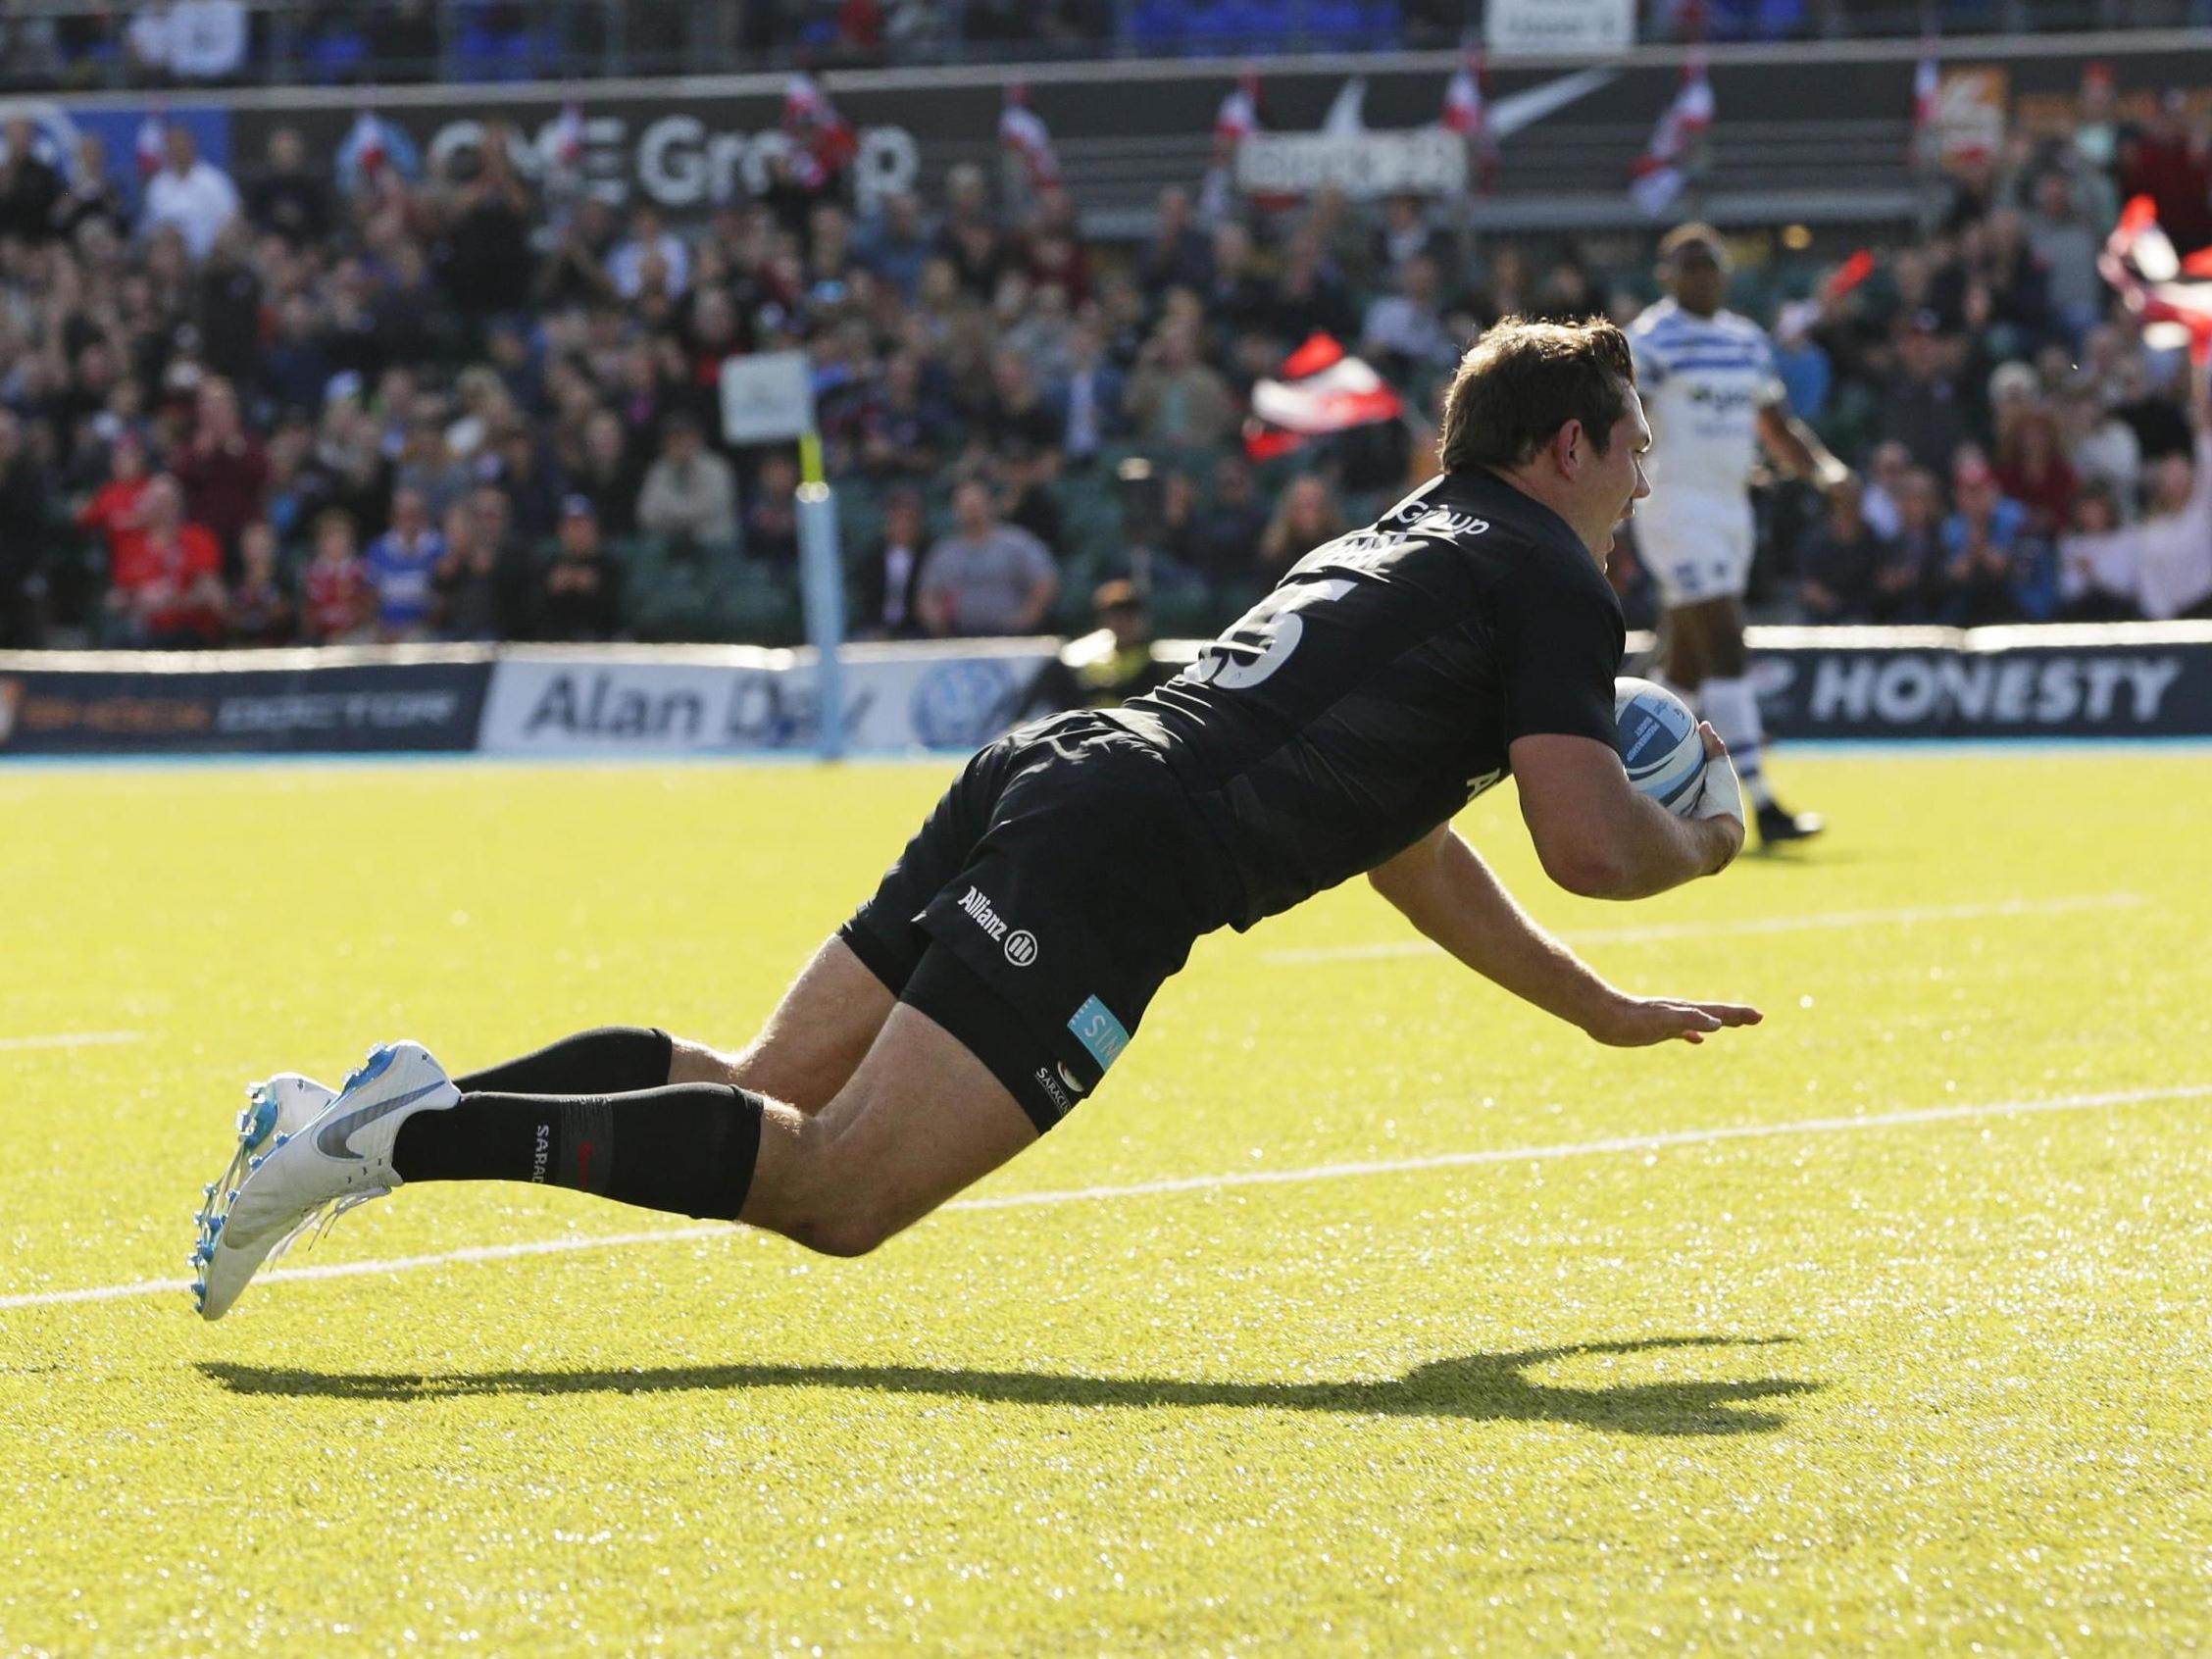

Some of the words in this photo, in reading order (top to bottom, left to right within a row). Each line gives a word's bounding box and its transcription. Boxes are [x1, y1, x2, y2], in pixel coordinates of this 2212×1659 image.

[1395, 499, 1490, 535] Group
[522, 669, 703, 740] Alan
[1811, 654, 2183, 724] HONESTY
[957, 884, 1008, 942] Allianz
